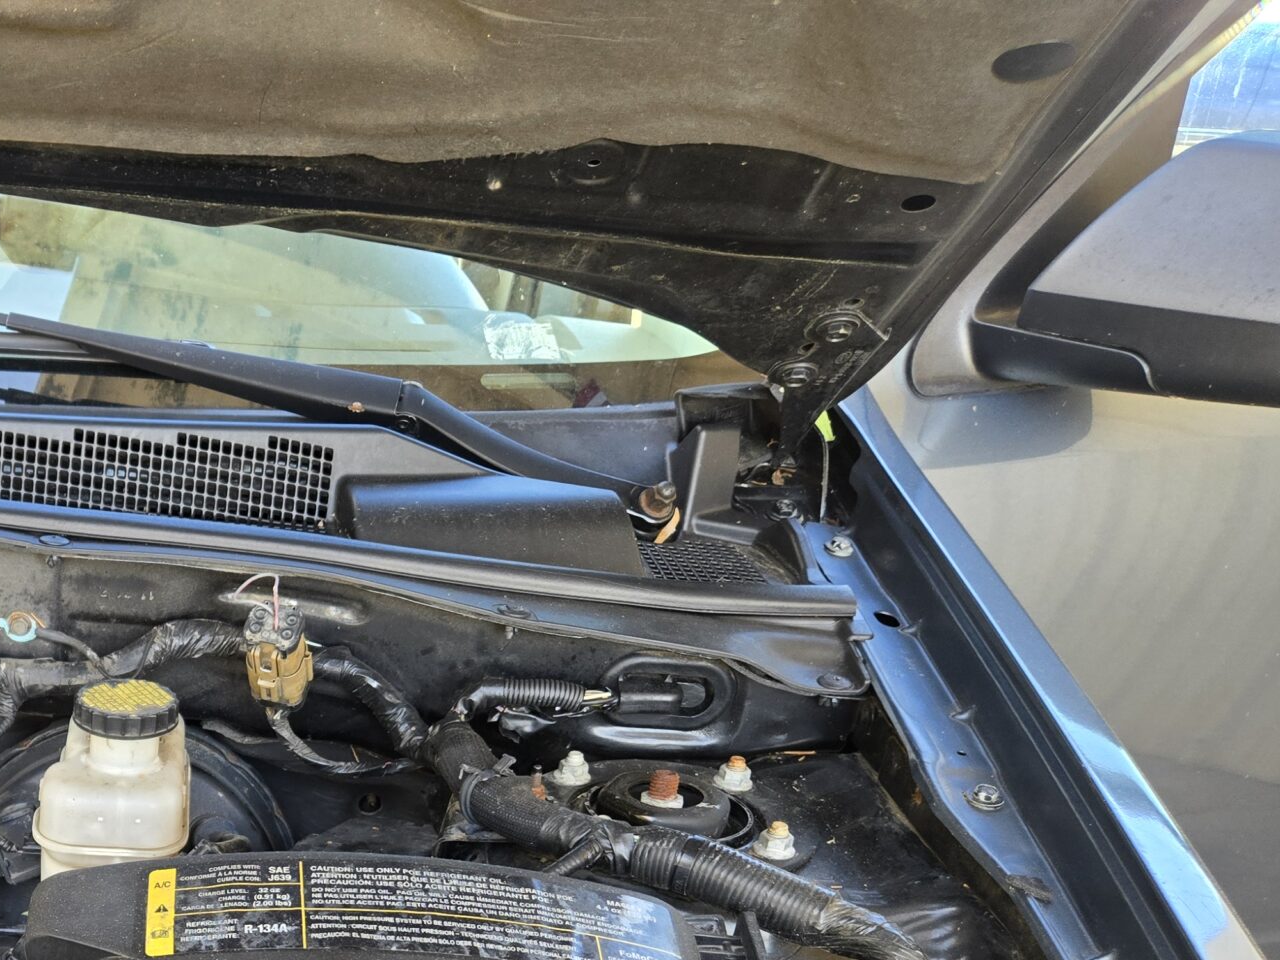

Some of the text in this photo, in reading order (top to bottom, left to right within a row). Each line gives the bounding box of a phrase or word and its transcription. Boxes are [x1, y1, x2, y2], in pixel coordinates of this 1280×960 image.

[269, 866, 290, 874] SAE
[180, 873, 216, 881] CONFORME
[423, 871, 487, 882] REFRIGERANT
[311, 878, 373, 886] PRECAUCIÓN:
[397, 880, 422, 888] SÓLO
[425, 883, 457, 892] ACEITE
[460, 887, 530, 900] REFRIGERANTE
[428, 903, 455, 911] ACEITE
[458, 906, 484, 914] CAUSA
[451, 899, 507, 910] COMPRESSEUR
[476, 897, 518, 907] IMMEDIATE
[520, 902, 573, 914] COMPRESSOR
[244, 924, 288, 933] R-134A
[421, 928, 454, 936] PRESSION
[411, 936, 437, 944] PRESIÓN
[517, 946, 529, 954] POR
